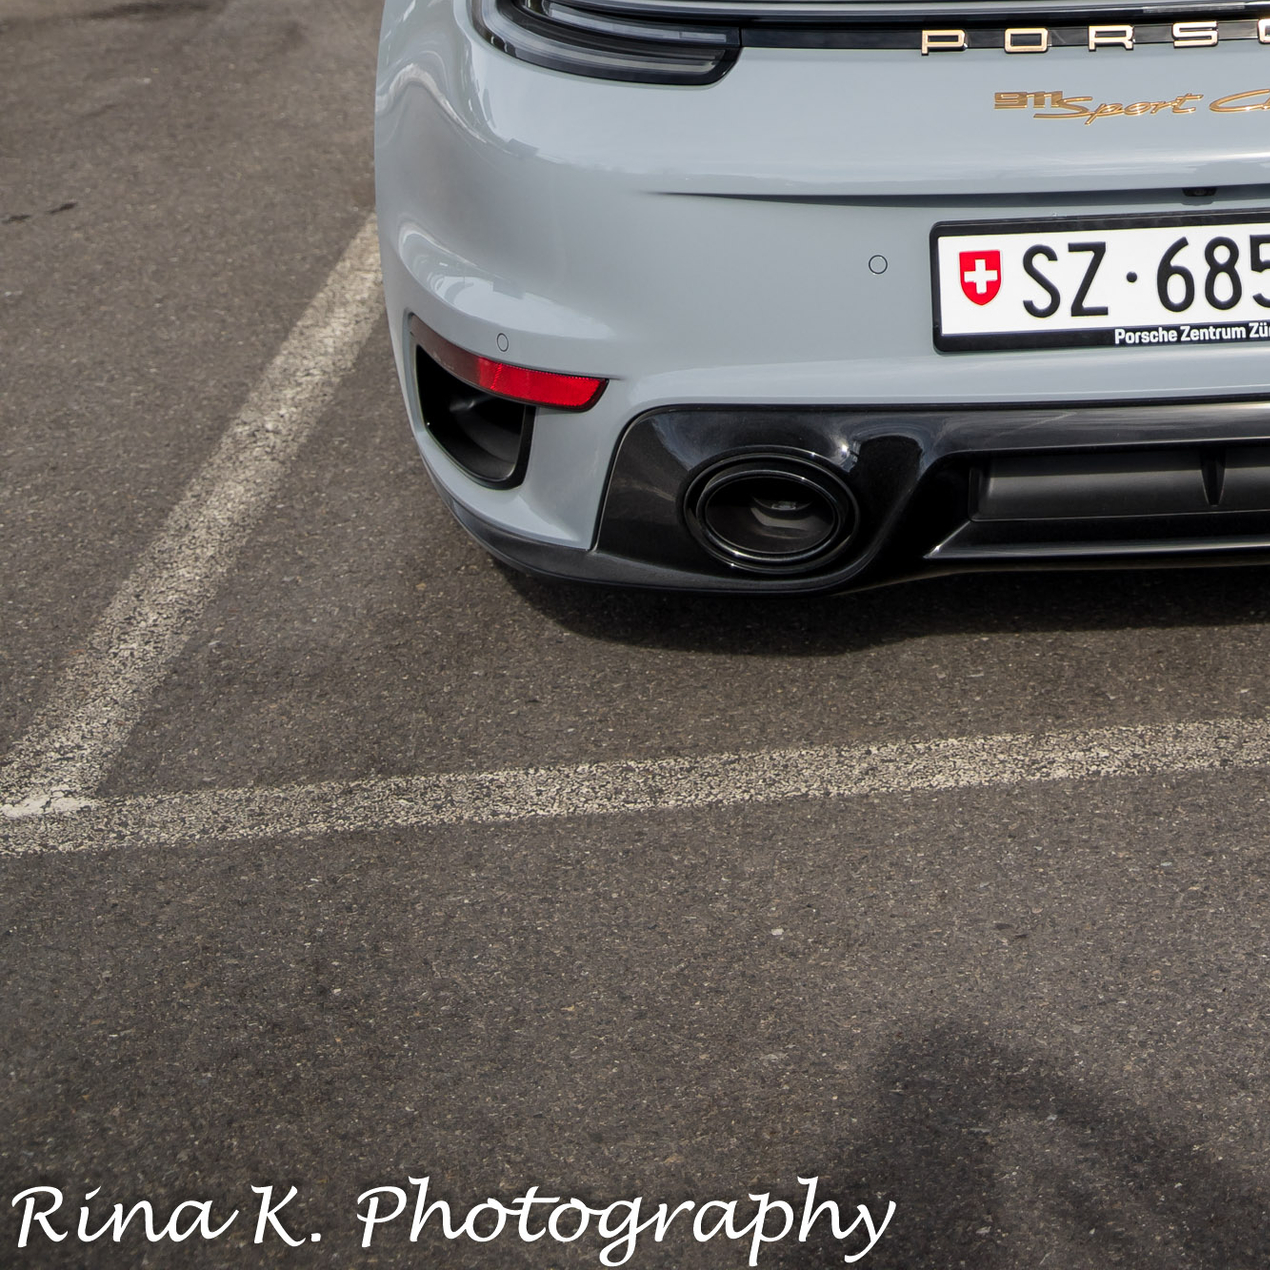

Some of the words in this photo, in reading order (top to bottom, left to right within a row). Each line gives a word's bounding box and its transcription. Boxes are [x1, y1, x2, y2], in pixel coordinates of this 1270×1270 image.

[994, 91, 1063, 109] 911
[1033, 93, 1203, 126] Sport
[1114, 325, 1178, 344] Porsche
[1180, 323, 1247, 342] Zentrum
